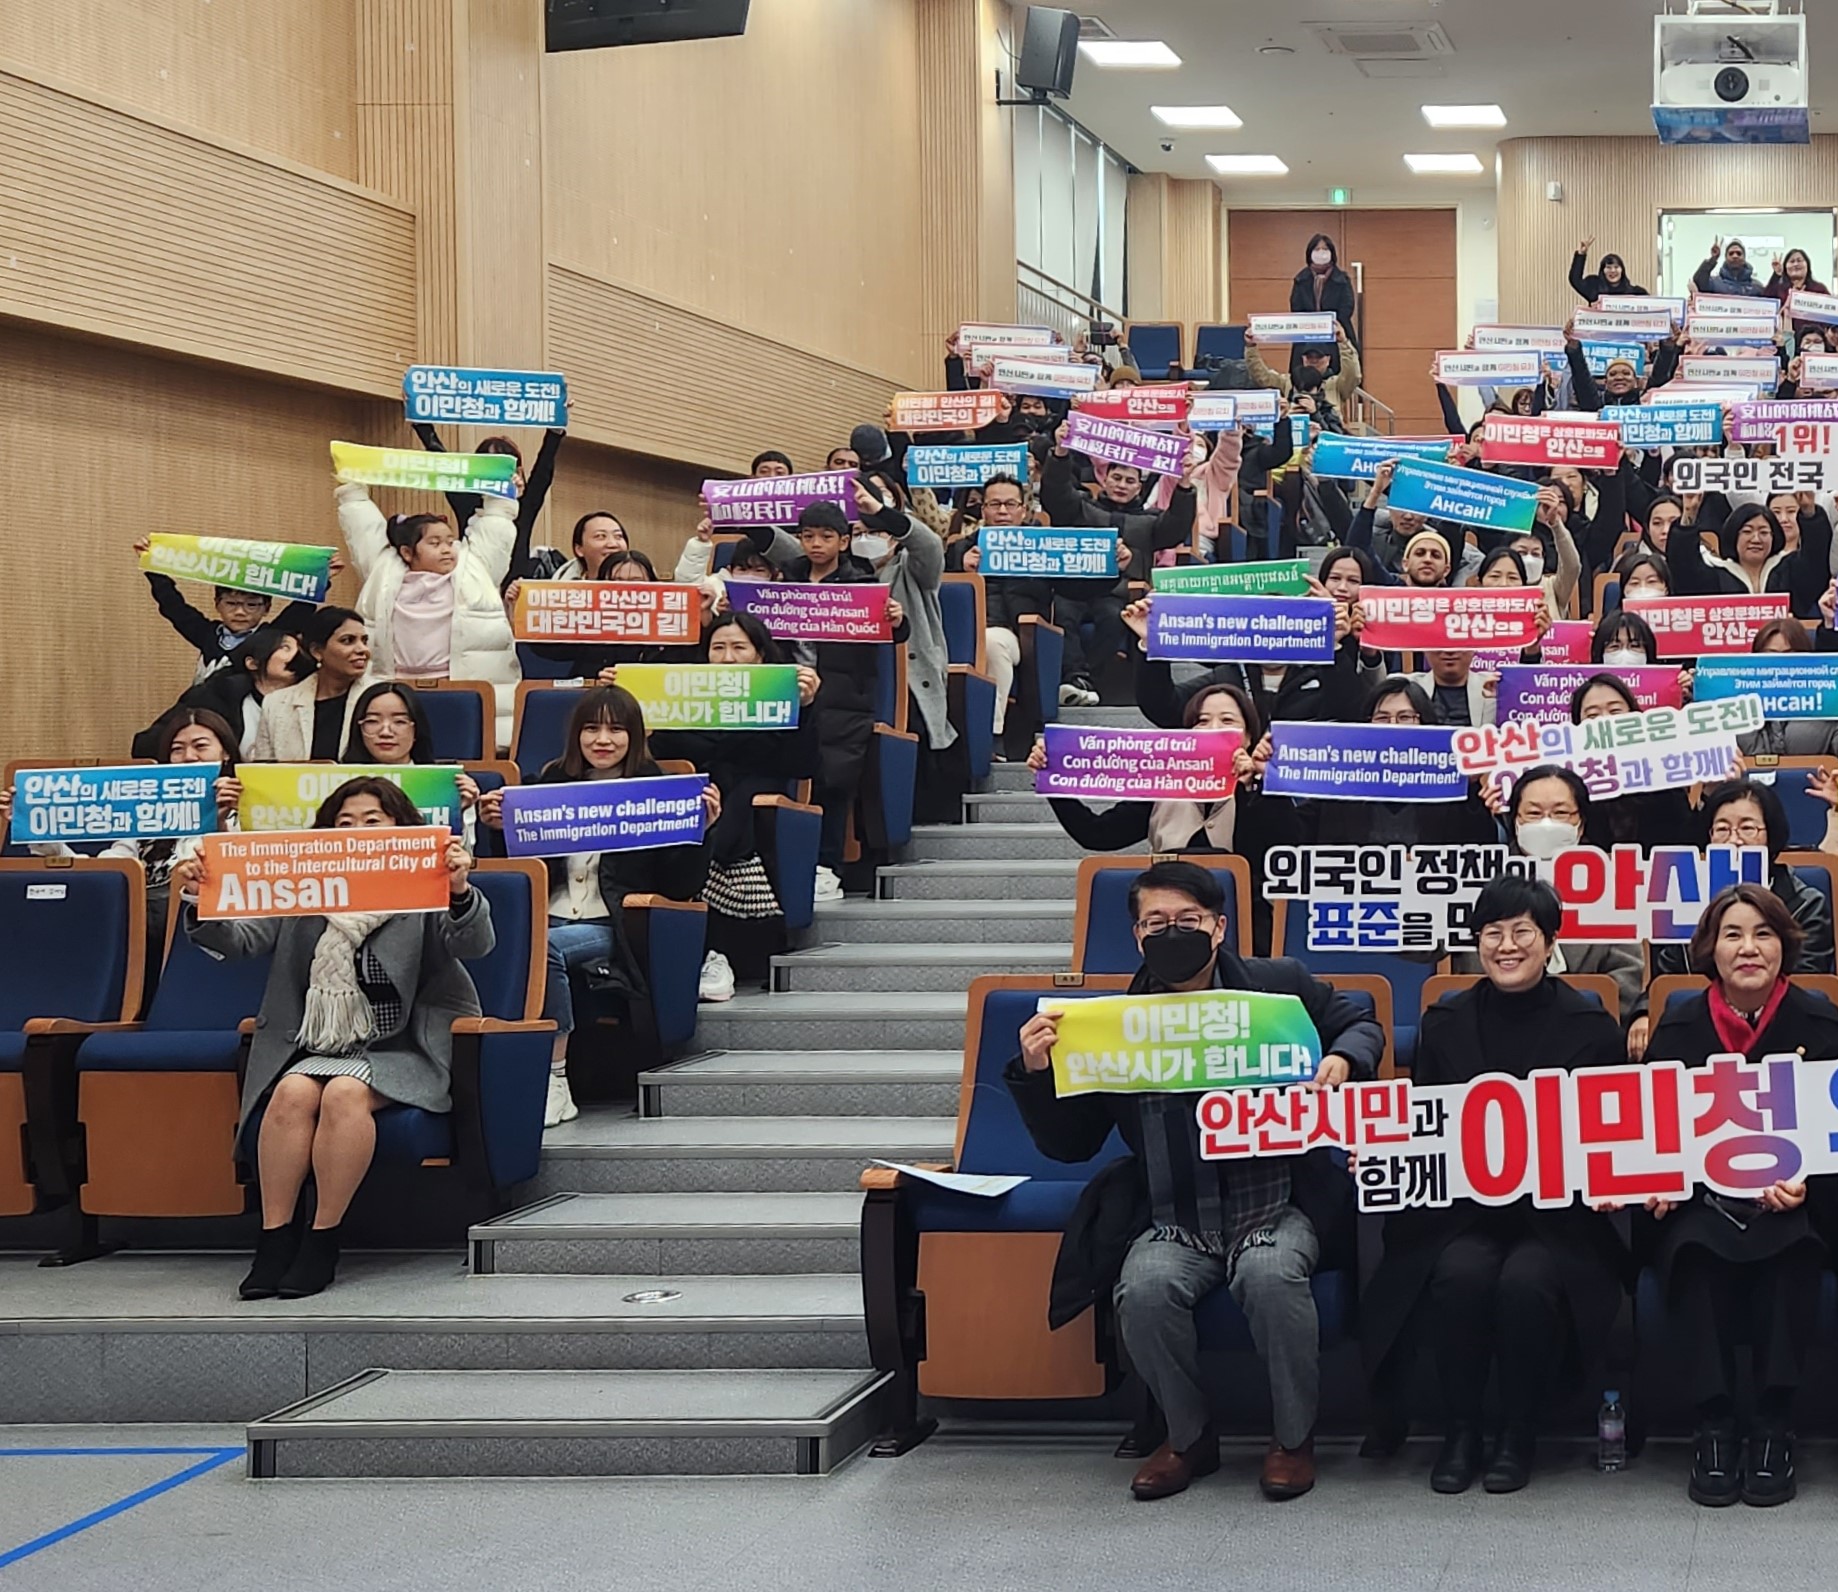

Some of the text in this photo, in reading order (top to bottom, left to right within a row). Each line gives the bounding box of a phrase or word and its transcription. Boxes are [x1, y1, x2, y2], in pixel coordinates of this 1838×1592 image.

[411, 371, 561, 399] 안산의 새로운 도전!
[416, 395, 556, 422] 이민청과 함께!
[1546, 438, 1605, 458] 안산으로
[1776, 425, 1830, 454] 1위!
[1677, 461, 1824, 491] 외국인 전국
[1430, 495, 1493, 520] Ансан!
[986, 530, 1036, 551] 안산의
[1038, 537, 1079, 551] 새로운
[989, 551, 1060, 572] 이민청과
[527, 589, 688, 610] 이민청! 안산의 길!
[1363, 598, 1450, 623] 이민청은
[527, 610, 688, 636] 대한민국의 길!
[1158, 613, 1327, 634] Ansan's new challenge!
[1445, 614, 1524, 640] 안산으로
[1158, 632, 1326, 651] The Immigration Department!
[664, 671, 751, 697] 이민청!
[718, 701, 792, 724] 합니다!
[1763, 692, 1823, 711] нсан!
[1155, 737, 1168, 751] di
[1457, 701, 1760, 769] 안산의 새로운 도전!
[1063, 755, 1090, 769] Con
[1167, 757, 1214, 771] Ansan!
[1278, 744, 1458, 769] Ansan's new challenge
[1663, 747, 1733, 783] 함께!
[24, 774, 206, 804] 안산의 새로운 도전!
[1049, 773, 1078, 787] Con
[1278, 766, 1460, 787] The Immigration Department!
[30, 801, 200, 836] 이민청과 함께!
[514, 796, 702, 825] Ansan's new challenge!
[516, 815, 700, 843] The Immigration Department!
[219, 835, 437, 858] The Immigration Department
[245, 853, 438, 876] to the Intercultural City of
[1268, 848, 1402, 896] 외국인
[217, 873, 350, 912] Ansan
[1311, 900, 1434, 950] 표준을
[1123, 1000, 1251, 1043] 이민청!
[1066, 1043, 1313, 1085] 안산시가 합니다!
[1201, 1083, 1448, 1160] 안산시민과
[1460, 1059, 1805, 1201] 이민청
[1358, 1151, 1450, 1208] 함께
